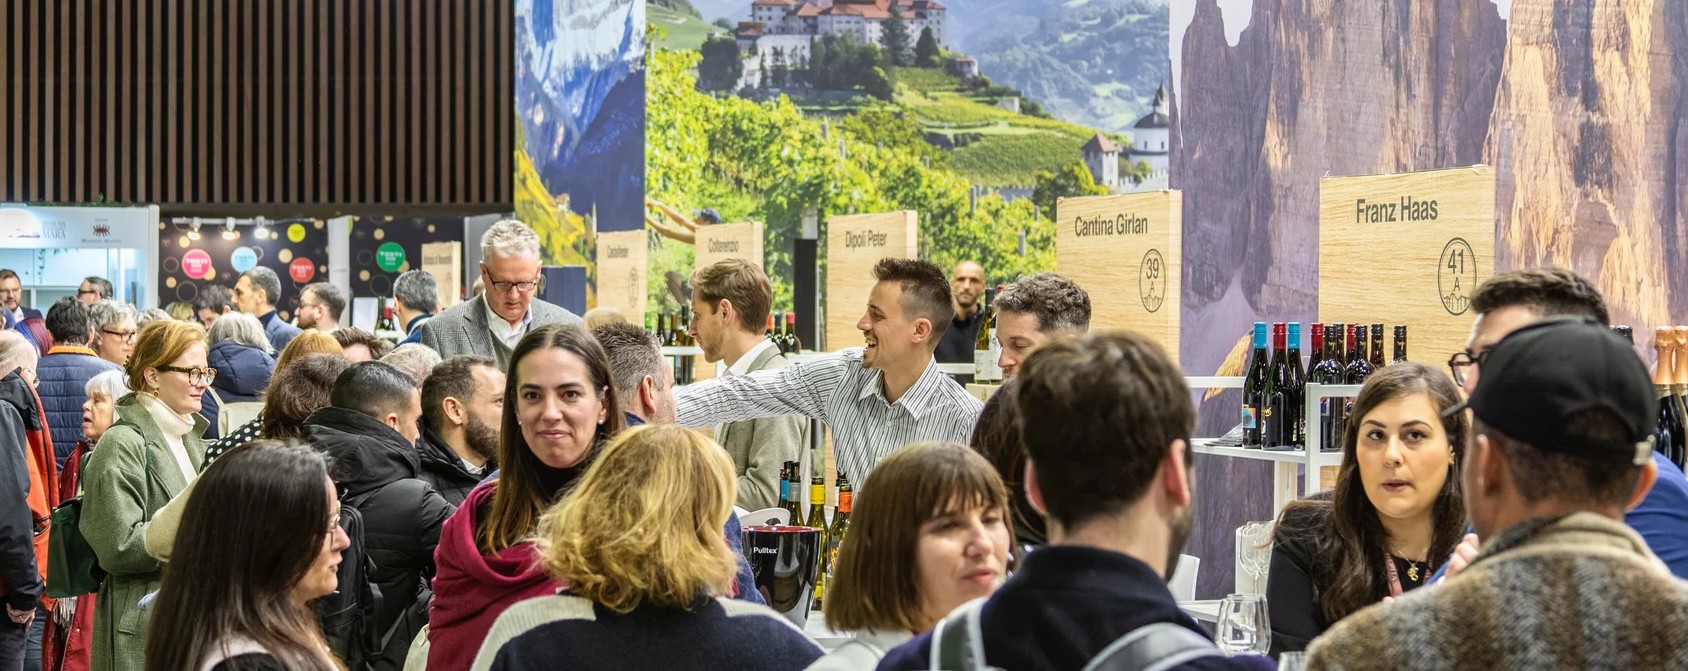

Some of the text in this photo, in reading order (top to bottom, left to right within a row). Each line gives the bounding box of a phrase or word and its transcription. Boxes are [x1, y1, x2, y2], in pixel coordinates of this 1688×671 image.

[1356, 195, 1438, 224] Franz Haas
[1074, 213, 1148, 237] Cantina Girlan
[845, 229, 887, 252] Dipoli Peter
[1146, 258, 1159, 279] 39
[1447, 249, 1464, 274] 41
[1149, 281, 1155, 293] A
[1453, 276, 1461, 291] A
[753, 546, 777, 554] Pulltex
